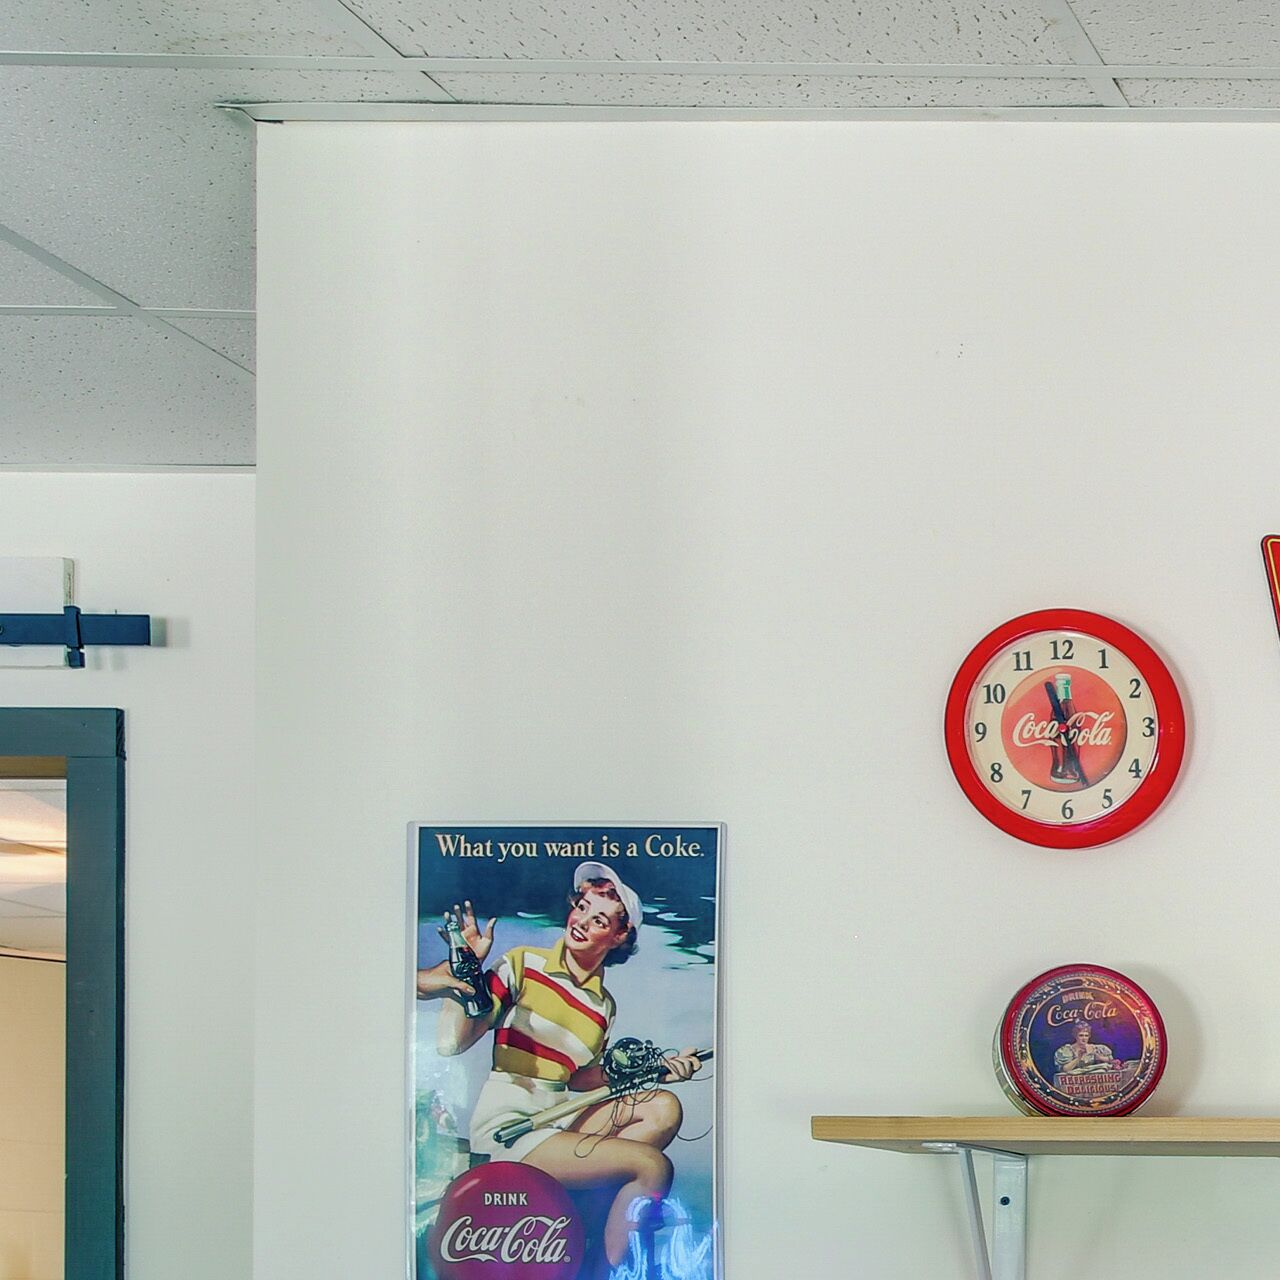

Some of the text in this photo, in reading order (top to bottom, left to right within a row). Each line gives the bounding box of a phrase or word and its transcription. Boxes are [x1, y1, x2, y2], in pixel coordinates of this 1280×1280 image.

[1050, 640, 1074, 660] 12
[1098, 648, 1109, 669] 1
[1012, 651, 1033, 671] 11
[983, 683, 1006, 704] 10
[1128, 678, 1142, 699] 2
[974, 722, 987, 742] 9
[1142, 717, 1155, 737] 3
[990, 762, 1003, 783] 8
[1128, 758, 1142, 779] 4
[1021, 789, 1031, 810] 7
[1061, 799, 1074, 819] 6
[1101, 789, 1113, 809] 5
[435, 833, 704, 862] What you want is a Coke.
[1047, 1000, 1119, 1027] Coca-Cola
[484, 1192, 528, 1206] DRINK
[440, 1216, 571, 1264] Coca-Cola
